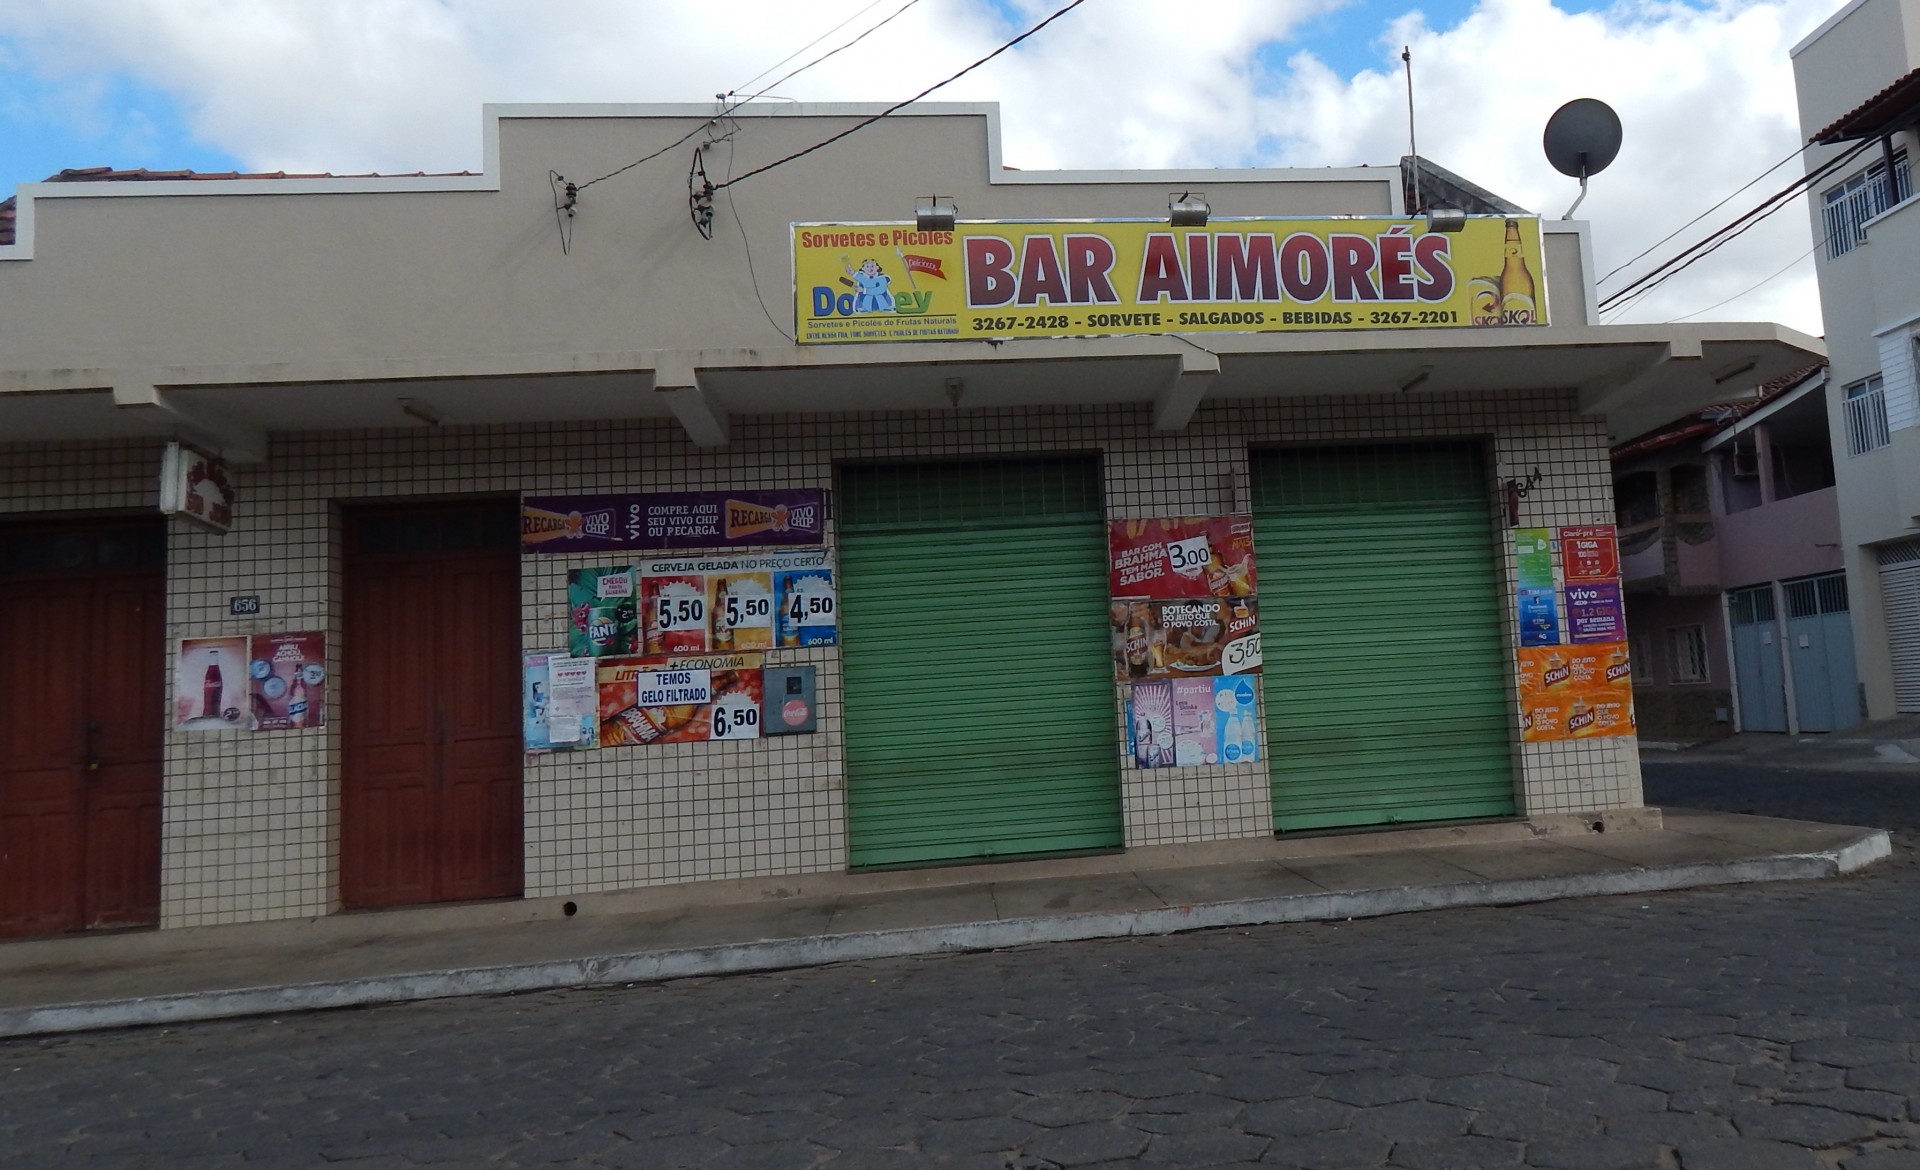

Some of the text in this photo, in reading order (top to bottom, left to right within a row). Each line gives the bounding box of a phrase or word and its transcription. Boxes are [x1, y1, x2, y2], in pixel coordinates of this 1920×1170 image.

[801, 231, 875, 248] Sorvetes
[879, 233, 889, 246] e
[963, 225, 1455, 308] BAR AIMORÉS
[808, 321, 846, 329] Sorvetes
[897, 318, 922, 326] Frutas
[924, 317, 957, 325] Naturais
[972, 316, 1069, 331] 3267-2428
[1088, 313, 1160, 327] SORVETE
[1179, 312, 1264, 325] SALGADOS
[1283, 311, 1352, 324] BEBIDAS
[1370, 311, 1458, 324] 3267-2201
[1474, 316, 1500, 326] SKO
[1503, 309, 1537, 324] SKOL
[648, 504, 718, 516] COMPRE AQUI
[790, 506, 814, 518] VIVO
[523, 516, 568, 534] RECARGA
[586, 513, 609, 525] VIVO
[626, 504, 640, 540] vivo
[648, 515, 719, 526] SEU VIVO CHIP
[730, 508, 772, 528] RECARGA
[791, 517, 814, 528] CHIP
[586, 524, 610, 535] CHIP
[648, 526, 720, 537] OU RECARGA.
[1122, 542, 1162, 558] BAR COM
[1576, 541, 1598, 549] 1 GIGA
[652, 557, 824, 572] CERVEJA GELADA NO PREÇO CERTO
[1114, 549, 1167, 569] BRAHMA
[1121, 560, 1162, 576] TEM MAIS
[1119, 568, 1165, 586] SABOR.
[1569, 588, 1597, 599] vivo
[234, 599, 256, 611] 656
[726, 597, 769, 626] 5,50
[790, 594, 833, 623] 4,50
[1162, 604, 1220, 615] BOTECANDO
[659, 599, 703, 628] 5,50
[1175, 613, 1194, 621] JEITO
[1195, 612, 1211, 620] QUE
[1171, 620, 1192, 628] POVO
[1193, 619, 1219, 627] GOSTA.
[1229, 638, 1261, 665] 3,50
[656, 673, 691, 685] TEMOS
[642, 688, 706, 703] GELO FILTRADO
[1177, 683, 1211, 696] #partiu
[621, 707, 660, 741] BRAHMA
[714, 707, 757, 737] 6,50
